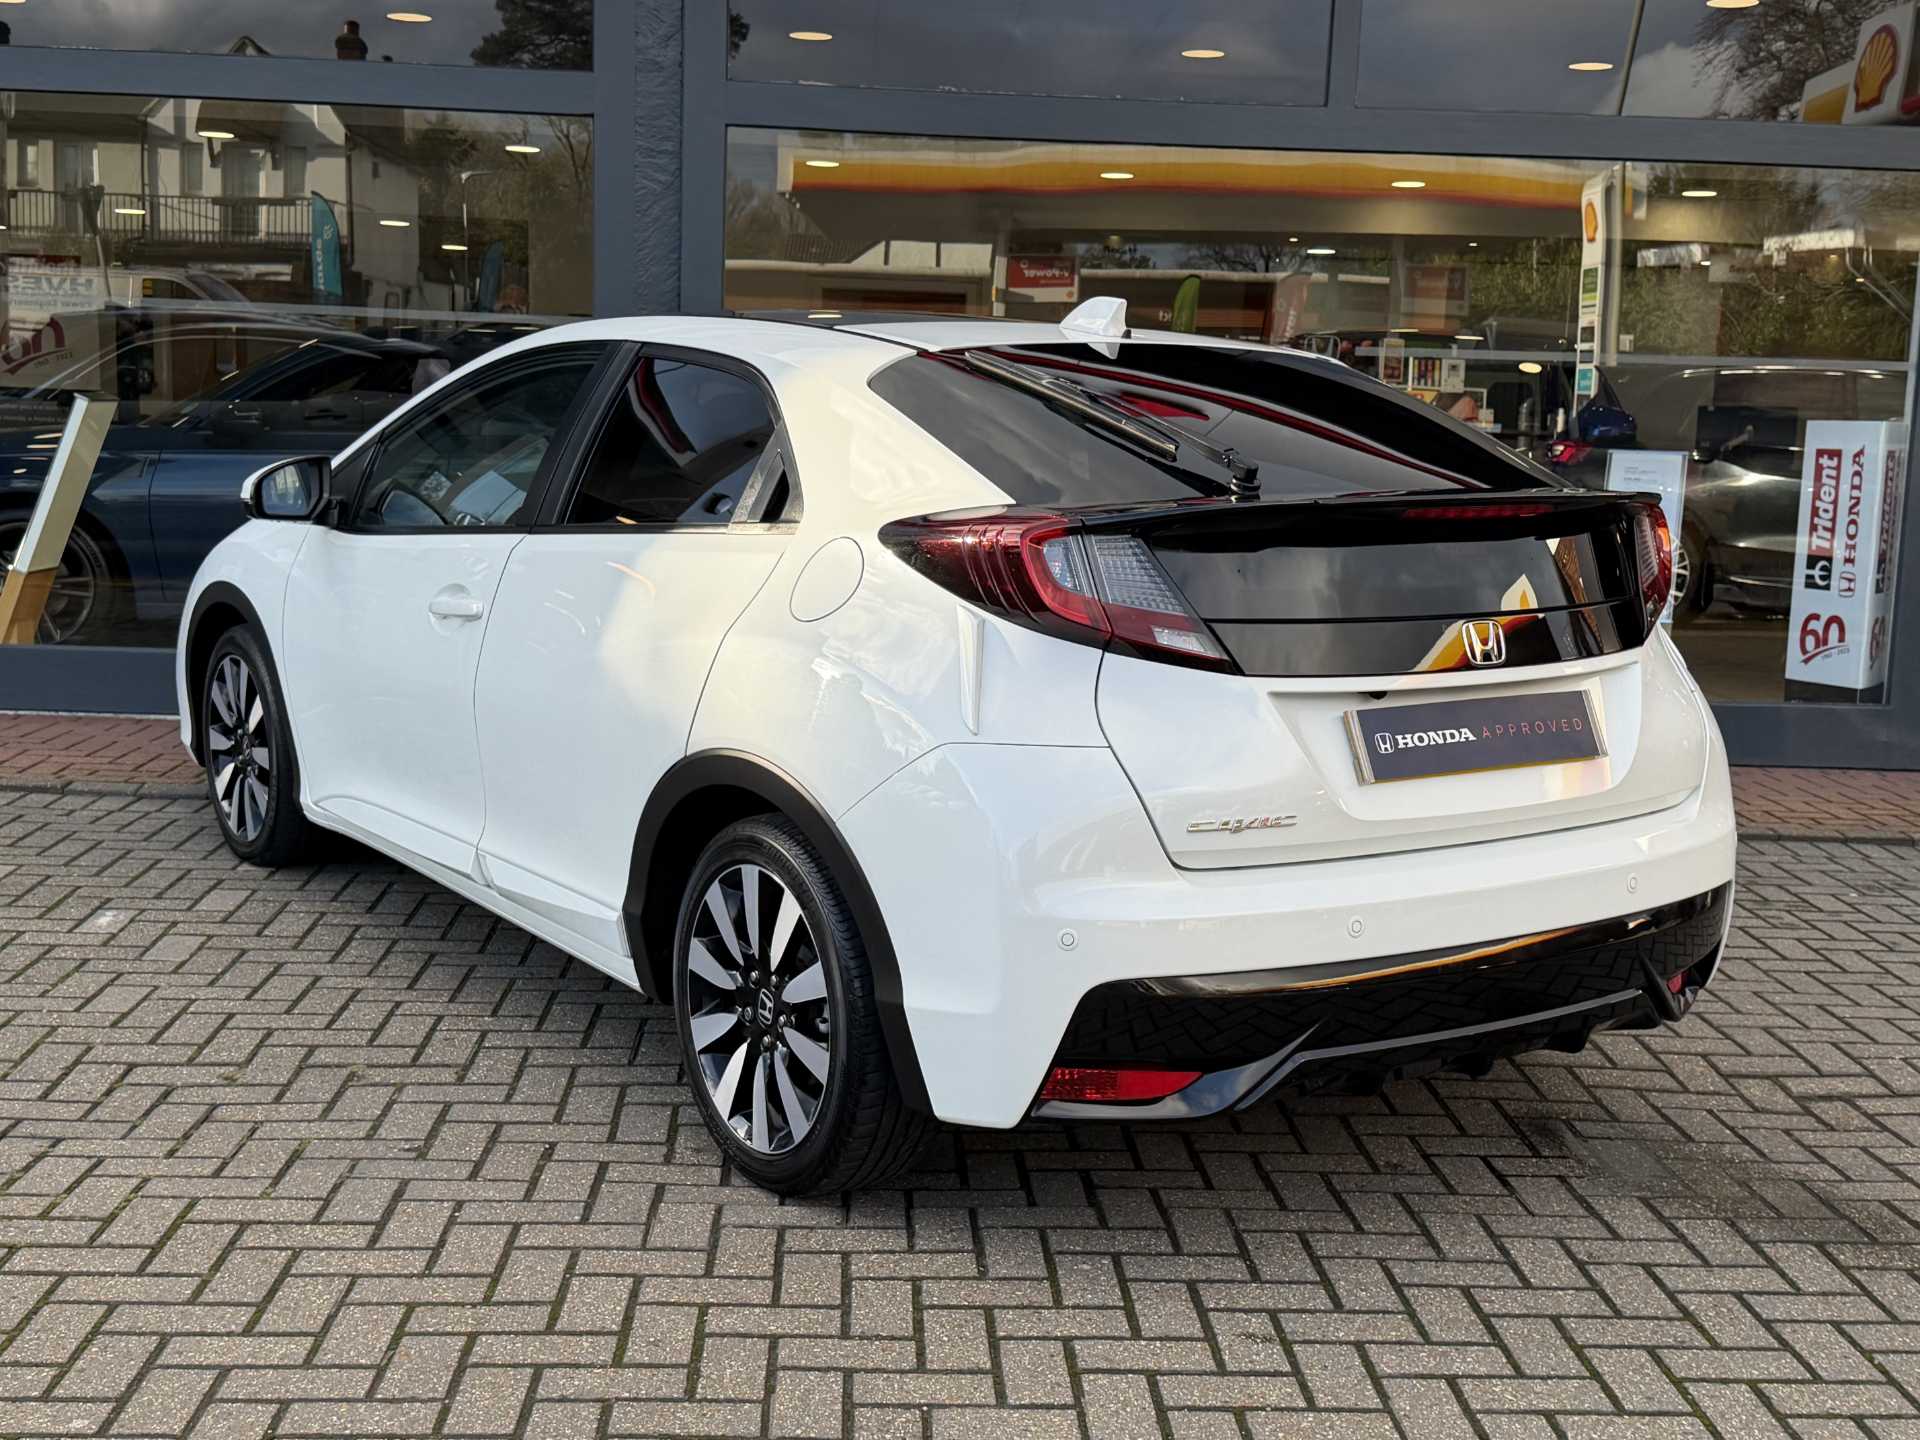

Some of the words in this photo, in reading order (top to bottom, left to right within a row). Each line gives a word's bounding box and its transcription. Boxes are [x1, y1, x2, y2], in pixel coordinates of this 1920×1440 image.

[1812, 454, 1840, 551] Trident
[1843, 443, 1866, 567] HONDA
[1799, 611, 1846, 657] 60
[1395, 727, 1478, 749] HONDA
[1482, 717, 1583, 739] APPROVED
